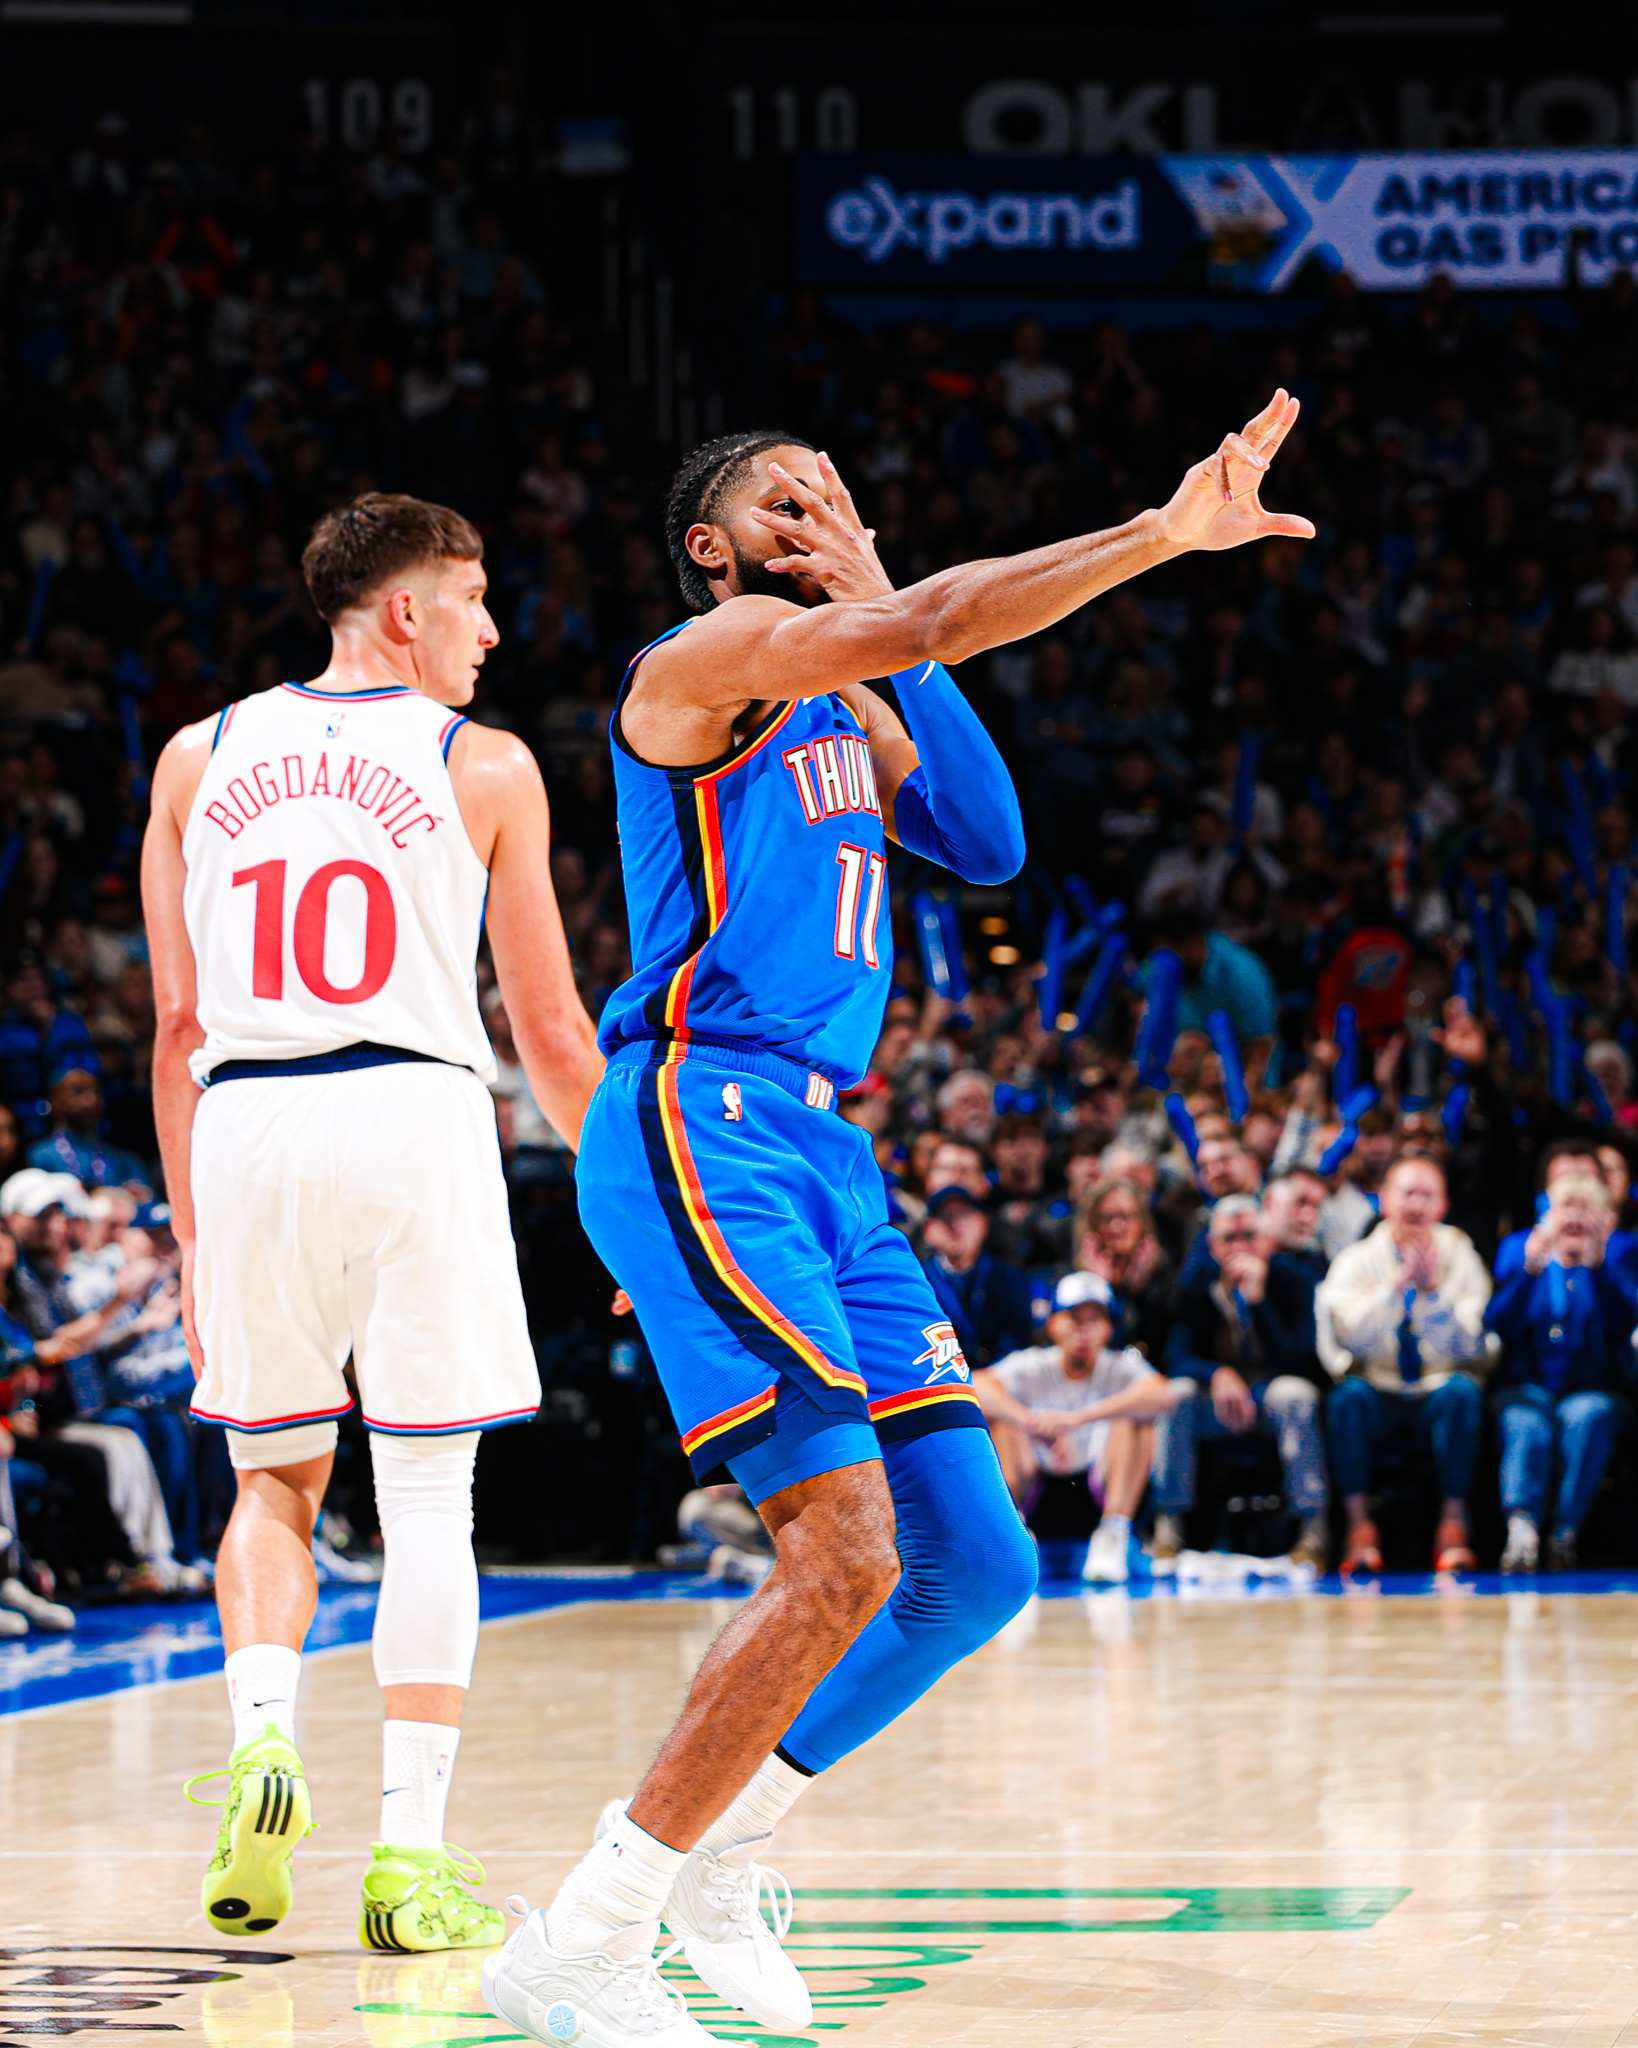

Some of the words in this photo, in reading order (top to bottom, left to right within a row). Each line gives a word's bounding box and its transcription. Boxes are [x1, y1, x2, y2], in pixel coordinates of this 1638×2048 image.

[302, 76, 434, 154] 109
[723, 82, 858, 161] 110
[825, 174, 1141, 264] expand
[1374, 170, 1638, 217] AMERIC
[205, 752, 444, 849] BOGDANOVIĆ
[782, 734, 885, 826] THUN
[231, 859, 396, 1005] 10
[834, 841, 887, 969] 11
